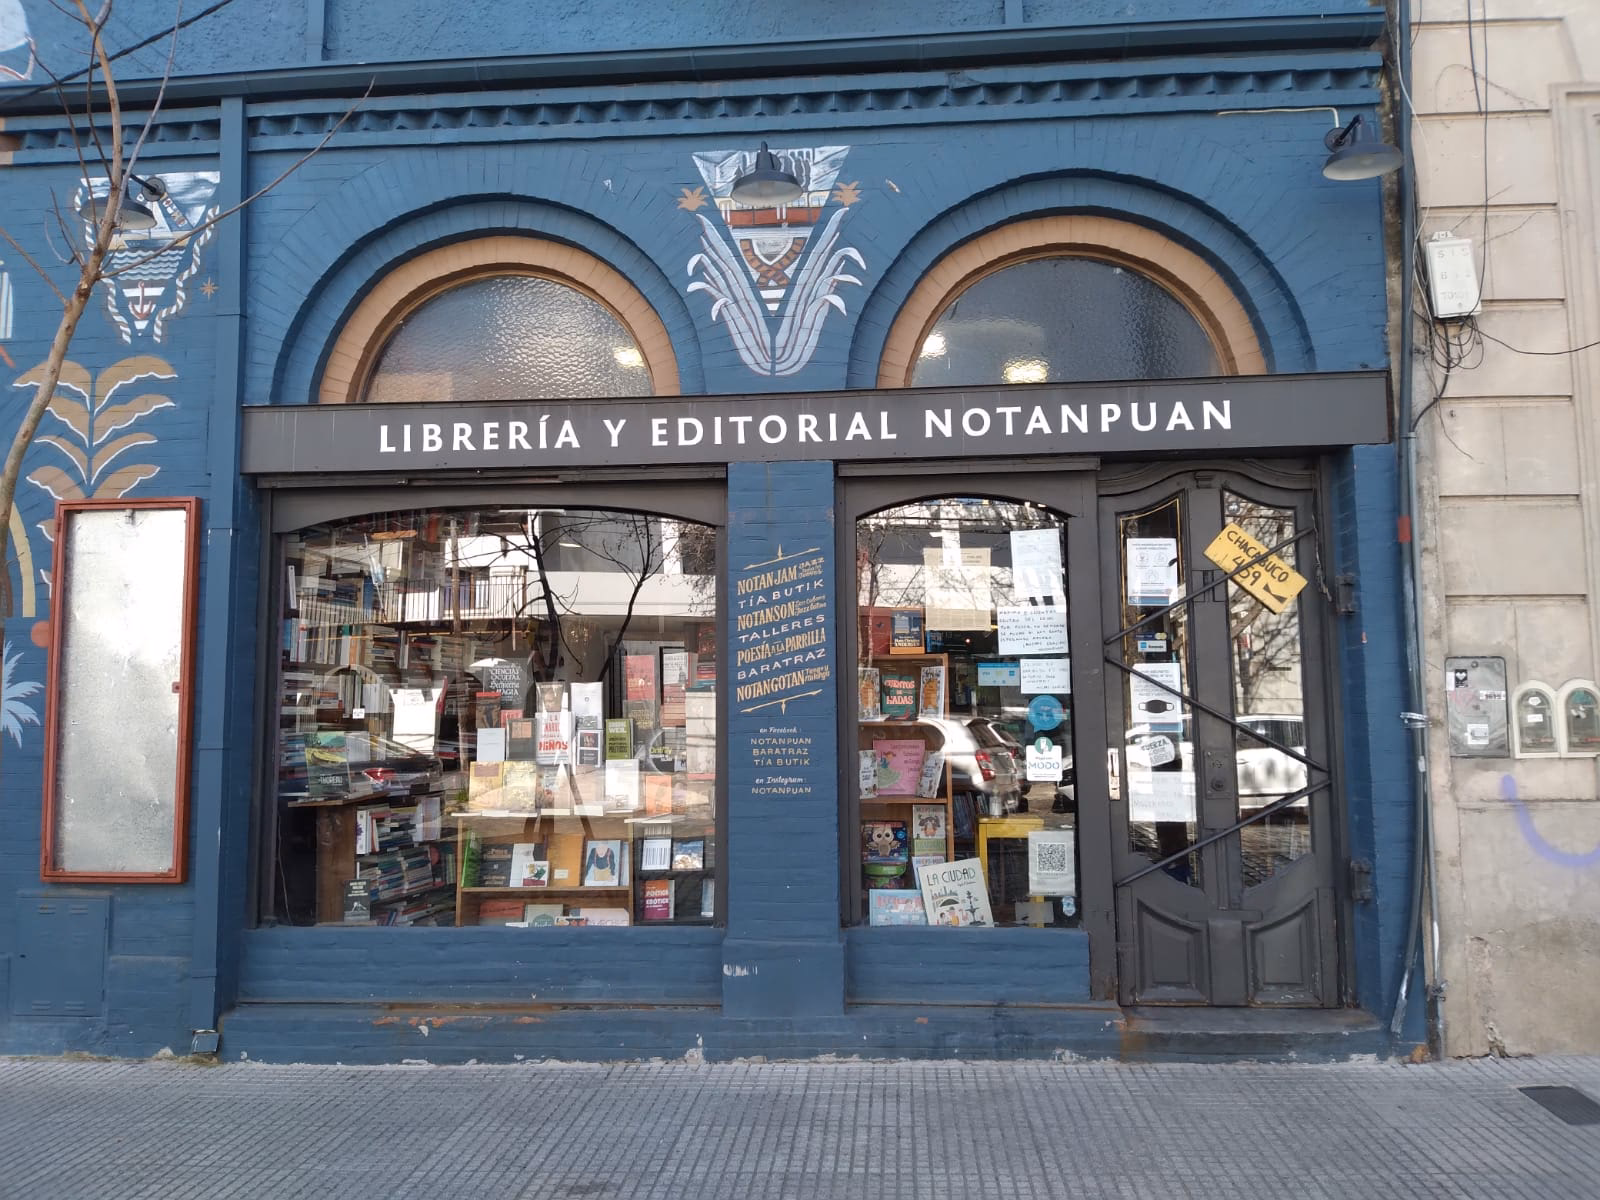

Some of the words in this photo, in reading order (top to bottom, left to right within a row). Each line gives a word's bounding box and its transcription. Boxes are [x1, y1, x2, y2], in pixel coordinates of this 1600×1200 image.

[379, 414, 581, 453] LIBRERÍA
[602, 418, 627, 448] Y
[650, 410, 898, 447] EDITORIAL
[923, 399, 1232, 438] NOTANPUAN
[1226, 530, 1289, 583] CHACBUCO
[738, 595, 768, 609] TÍA
[772, 578, 824, 600] BUTIK
[738, 614, 825, 643] TALLERES
[737, 640, 772, 667] POESÍA
[785, 627, 826, 653] PARRILLA
[737, 648, 826, 680] BARATRAZ
[886, 695, 914, 705] HADAS
[751, 737, 812, 745] NOTANPUAN
[752, 748, 809, 756] BARATRAZ
[776, 758, 810, 766] BUTIK
[1028, 761, 1060, 770] MODO
[926, 873, 939, 886] LA
[941, 867, 976, 883] CIUDAD
